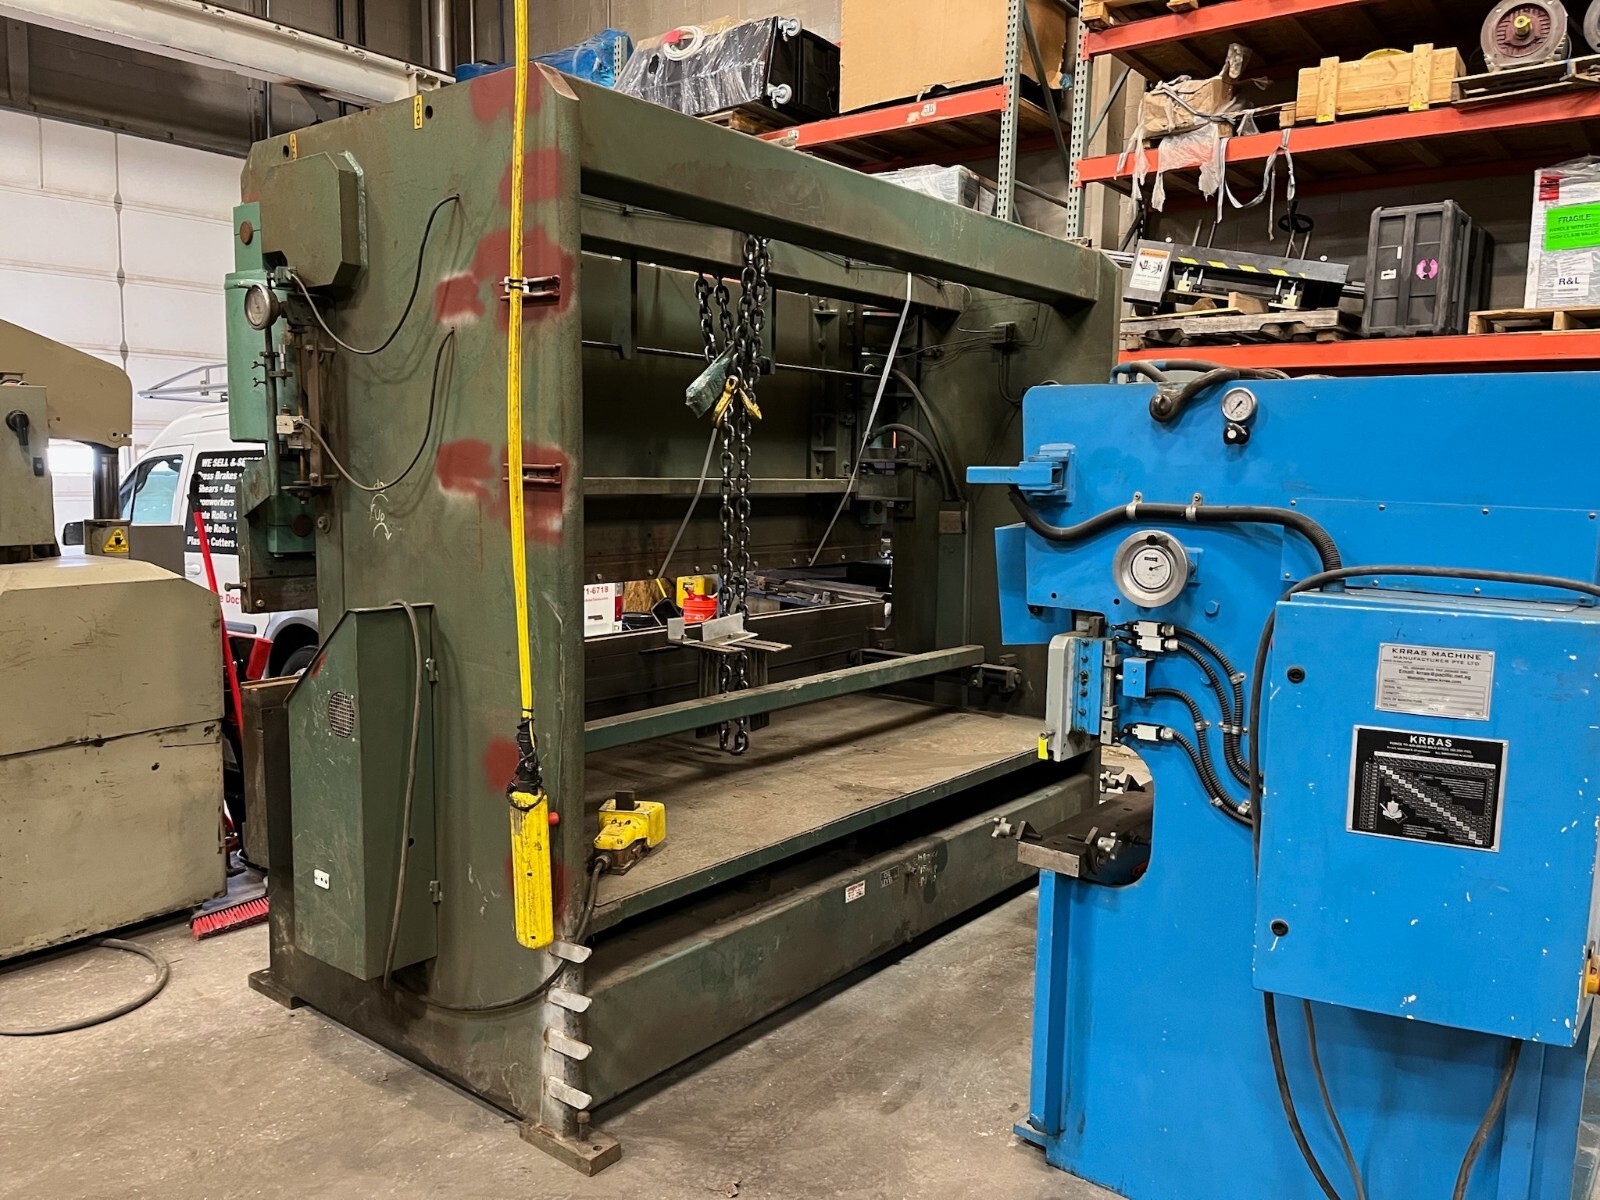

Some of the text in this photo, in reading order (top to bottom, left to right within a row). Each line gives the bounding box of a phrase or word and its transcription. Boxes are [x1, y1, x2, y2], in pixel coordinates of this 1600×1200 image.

[1558, 214, 1591, 223] FRAGILE
[1559, 277, 1581, 286] R&L
[202, 459, 212, 467] WE
[212, 458, 229, 467] SELL
[230, 458, 237, 467] &
[215, 471, 237, 480] Brakes
[211, 511, 227, 520] Rolls
[213, 524, 230, 534] Rolls
[211, 537, 235, 548] Cutters
[585, 586, 609, 595] 1-6718
[1392, 648, 1482, 660] KRRAS MACHINE
[1393, 655, 1449, 663] MANUFACTURER
[1409, 735, 1453, 748] KRRAS
